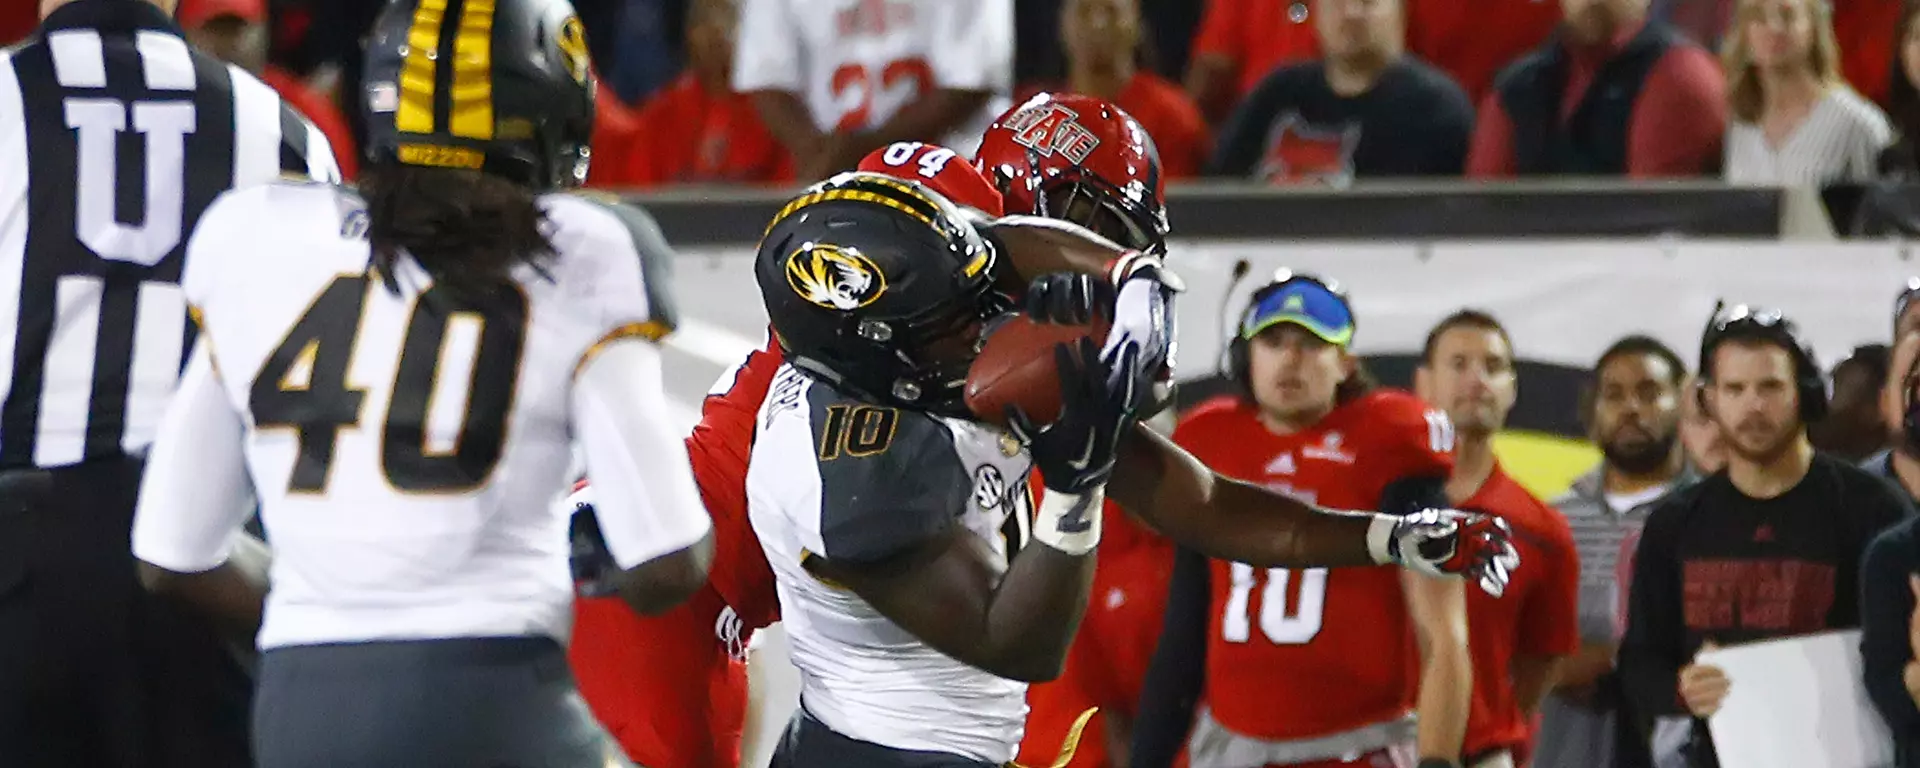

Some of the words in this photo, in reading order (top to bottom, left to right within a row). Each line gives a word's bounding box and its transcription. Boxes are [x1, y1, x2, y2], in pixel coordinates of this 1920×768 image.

[64, 98, 197, 267] U
[248, 270, 530, 497] 40
[819, 404, 899, 461] 10
[1222, 561, 1328, 644] 10
